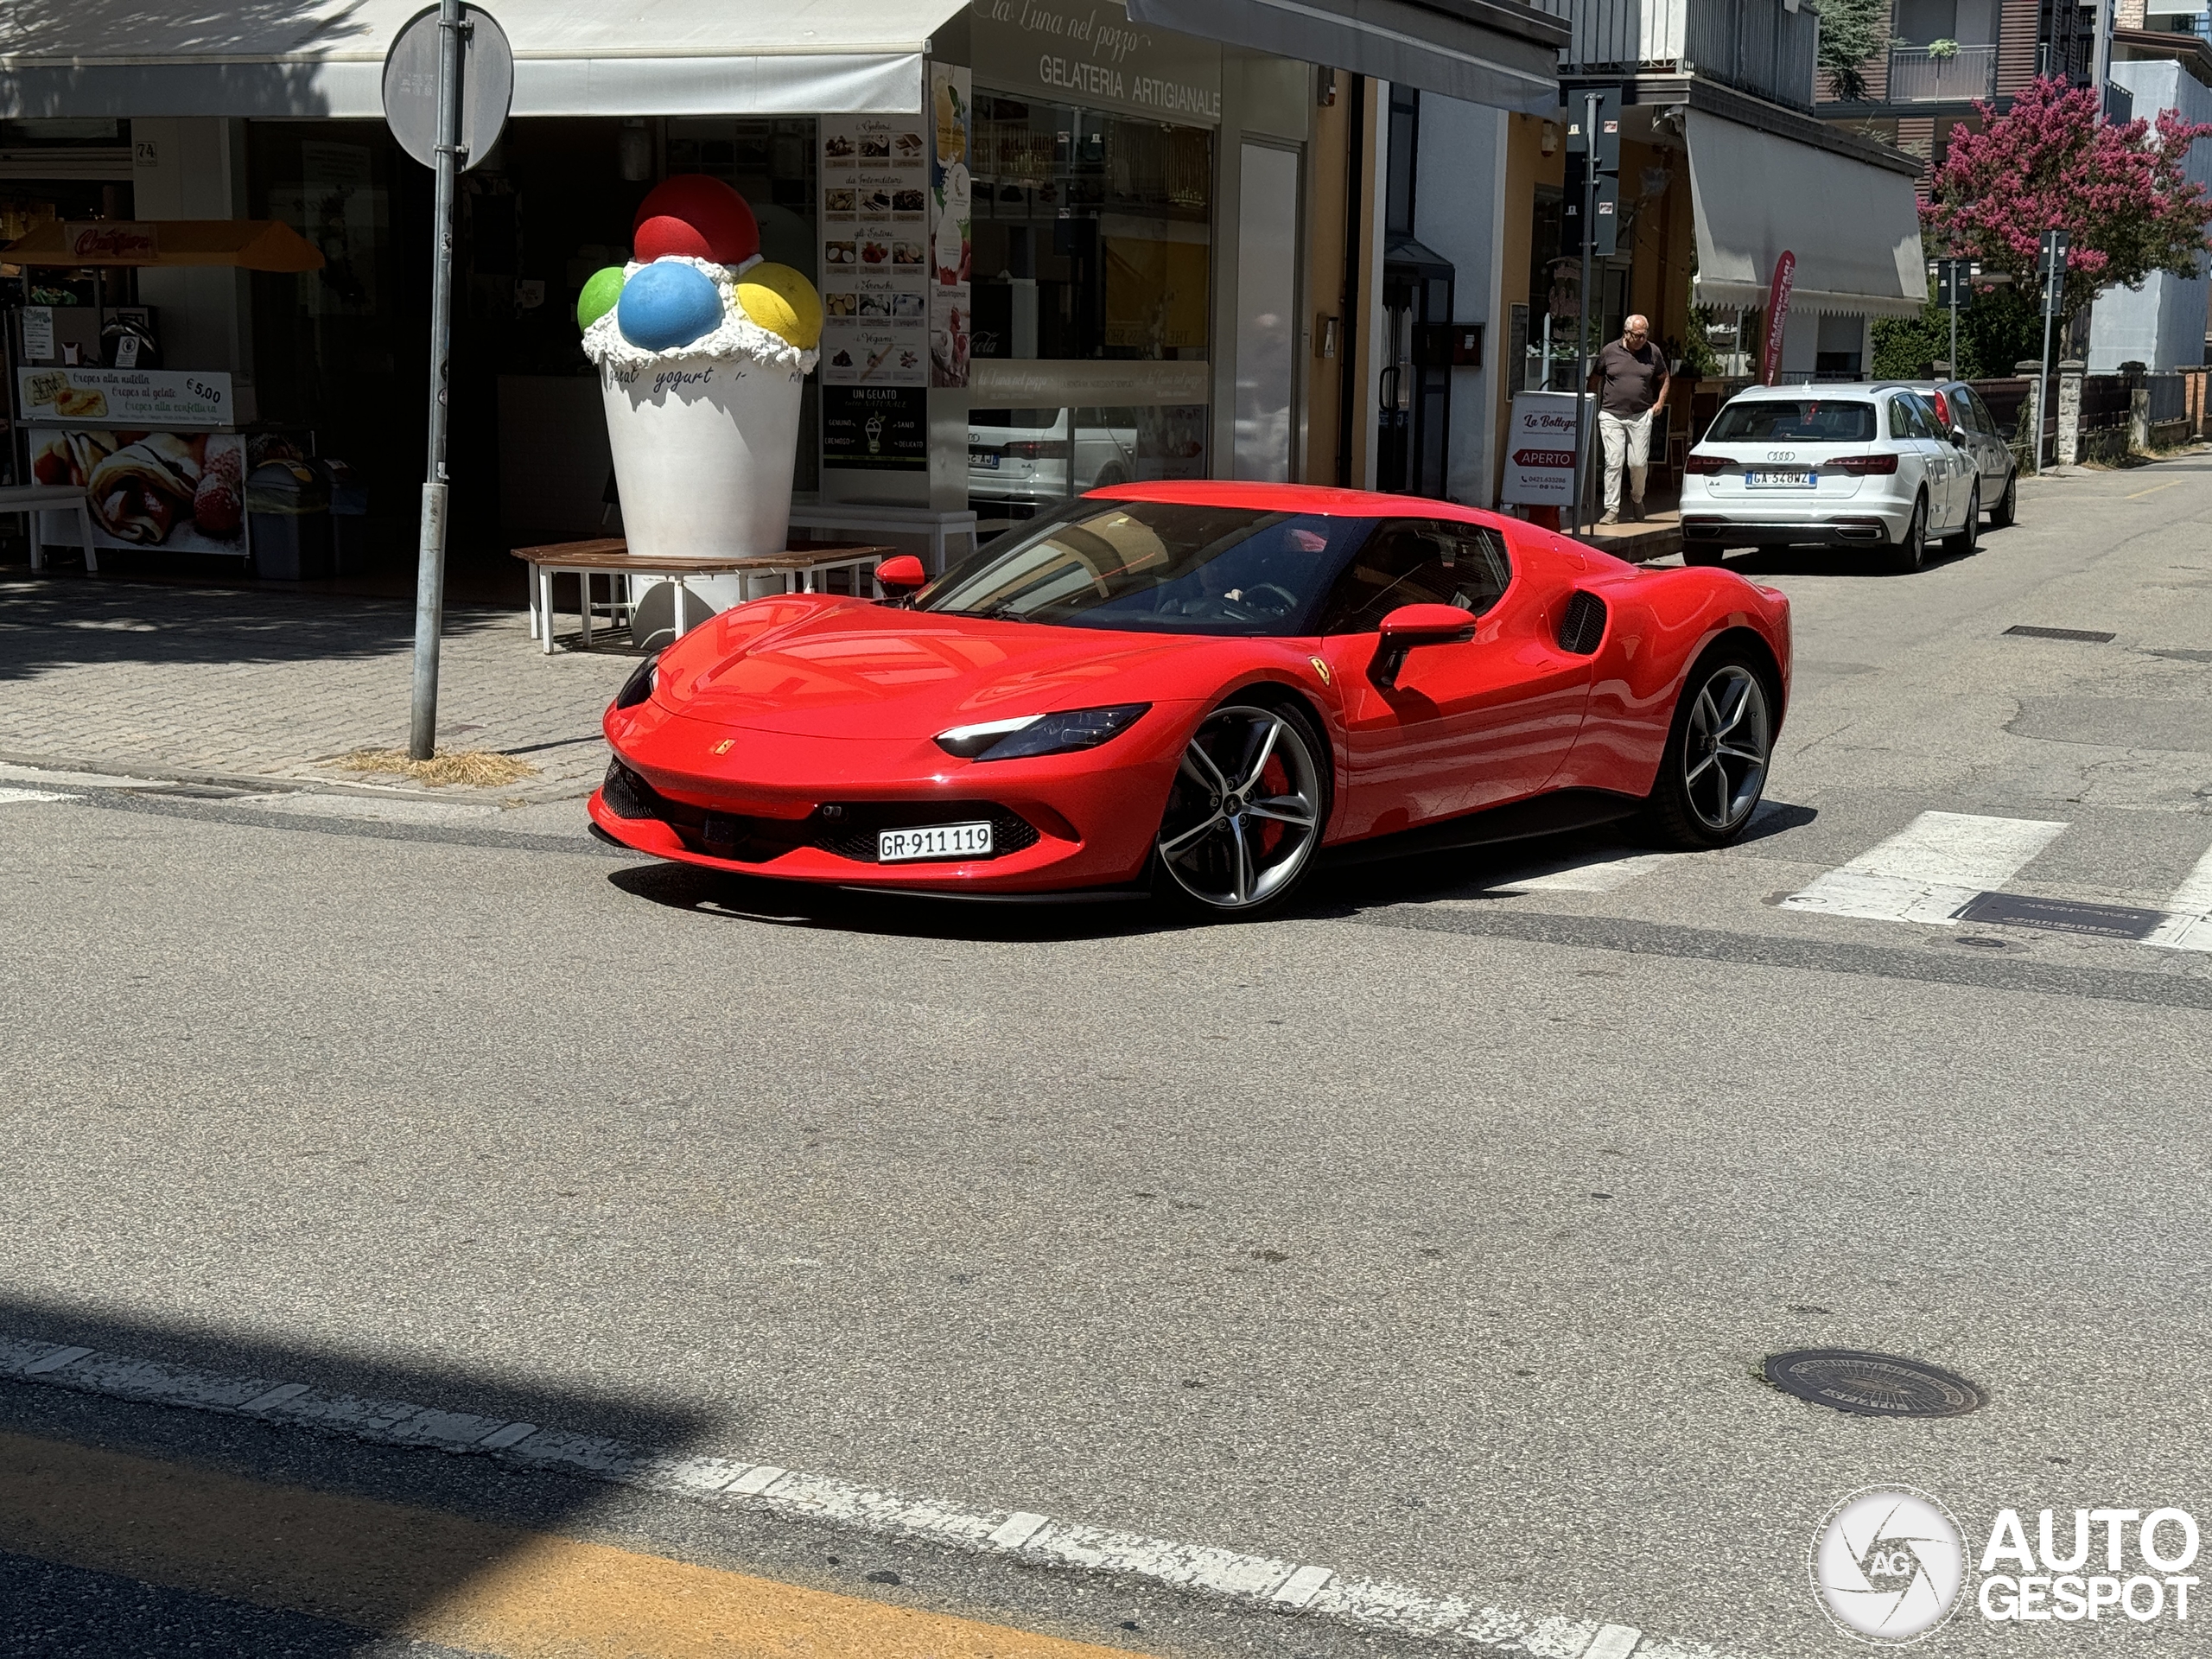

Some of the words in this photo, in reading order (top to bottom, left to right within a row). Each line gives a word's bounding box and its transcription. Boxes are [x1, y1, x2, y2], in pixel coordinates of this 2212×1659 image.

[1017, 0, 1064, 35] Luna
[1067, 9, 1096, 41] nel
[1093, 26, 1151, 63] pozzo
[1039, 54, 1124, 99] GELATERIA
[1132, 75, 1221, 118] ARTIGIANALE
[137, 143, 154, 157] 74
[845, 175, 856, 184] da
[861, 333, 893, 345] Vegani
[103, 373, 119, 385] alla
[121, 374, 150, 385] nutella
[608, 368, 639, 390] gelat
[653, 365, 715, 394] yogurt
[141, 388, 150, 397] al
[194, 382, 220, 404] 5,00
[853, 389, 865, 399] UN
[867, 389, 897, 400] GELATO
[155, 403, 172, 412] alla
[864, 400, 907, 409] NATURALE
[829, 419, 852, 428] GENUINO
[1524, 414, 1539, 428] La
[1540, 415, 1577, 432] Bottega
[824, 437, 851, 448] CREMOSO
[1521, 452, 1571, 465] APERTO
[1754, 472, 1768, 484] GA
[1771, 472, 1808, 484] 348WZ
